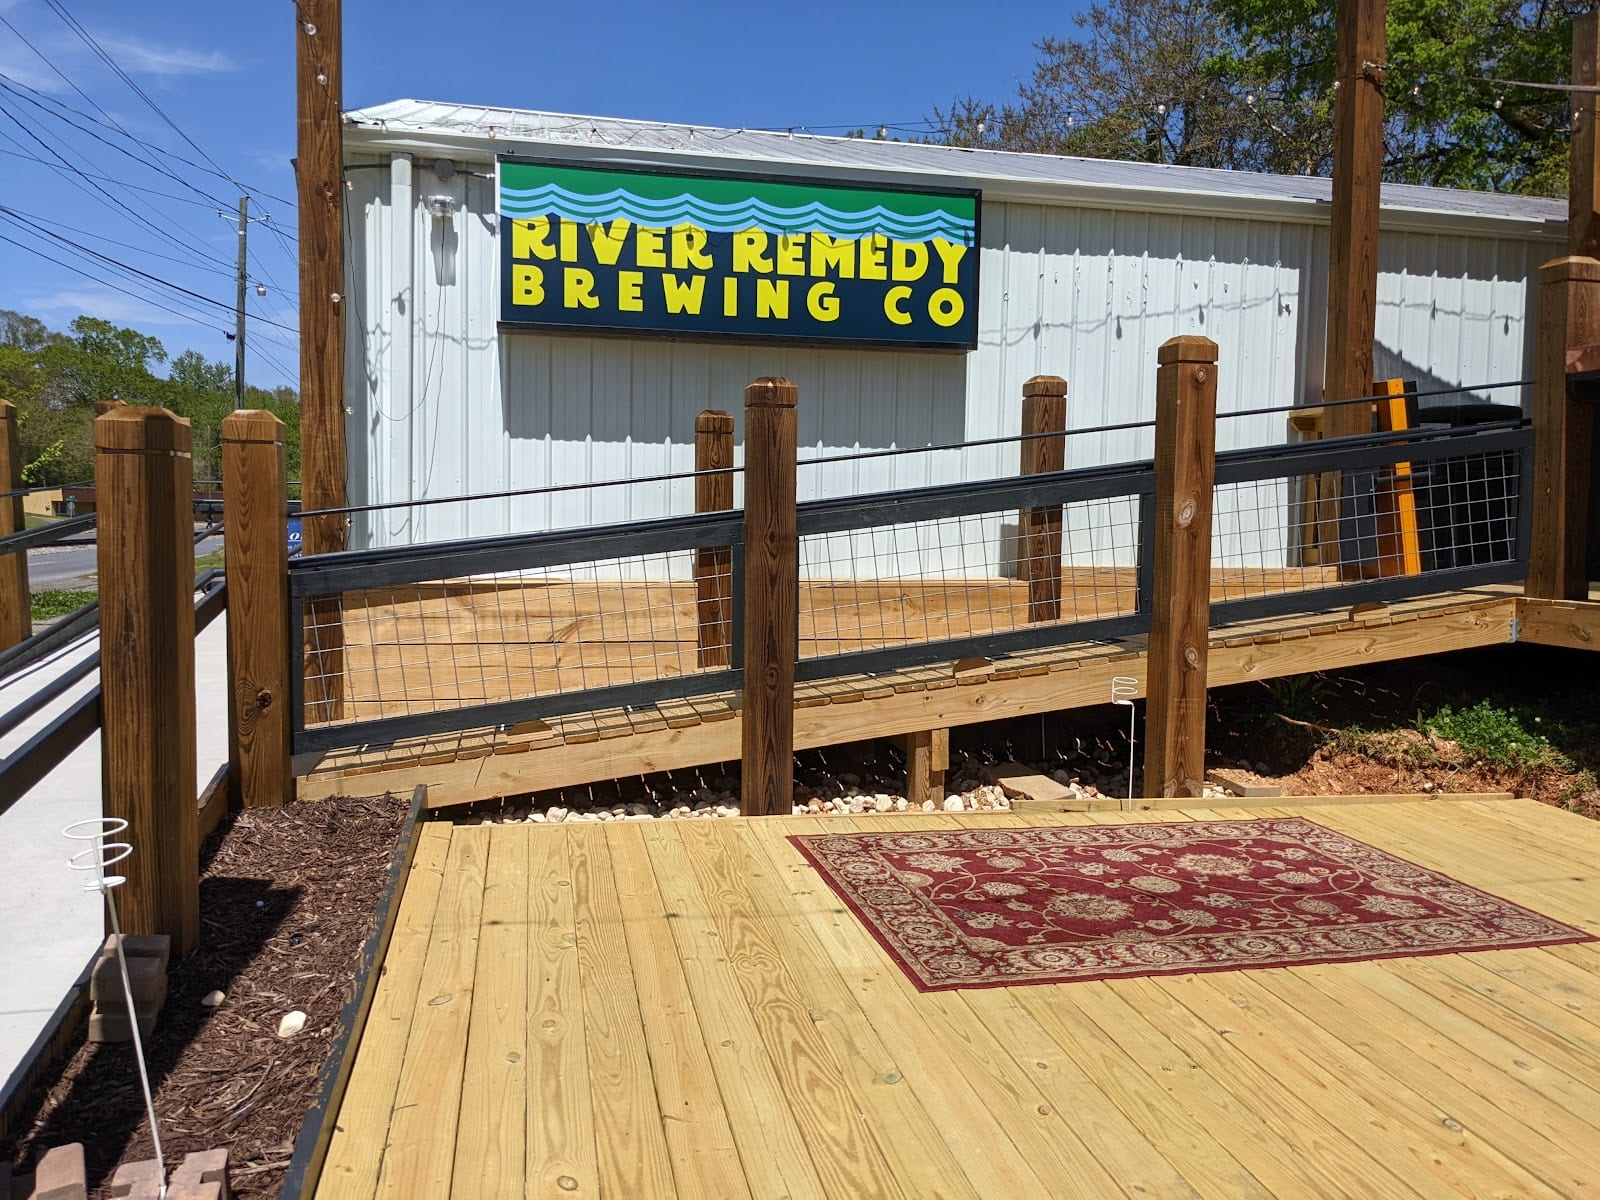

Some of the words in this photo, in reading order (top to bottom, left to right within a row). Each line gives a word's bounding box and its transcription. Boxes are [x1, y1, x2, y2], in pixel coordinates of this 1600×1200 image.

[512, 215, 713, 270] RIVER
[733, 226, 969, 284] REMEDY
[512, 265, 840, 322] BREWING
[883, 286, 965, 327] CO
